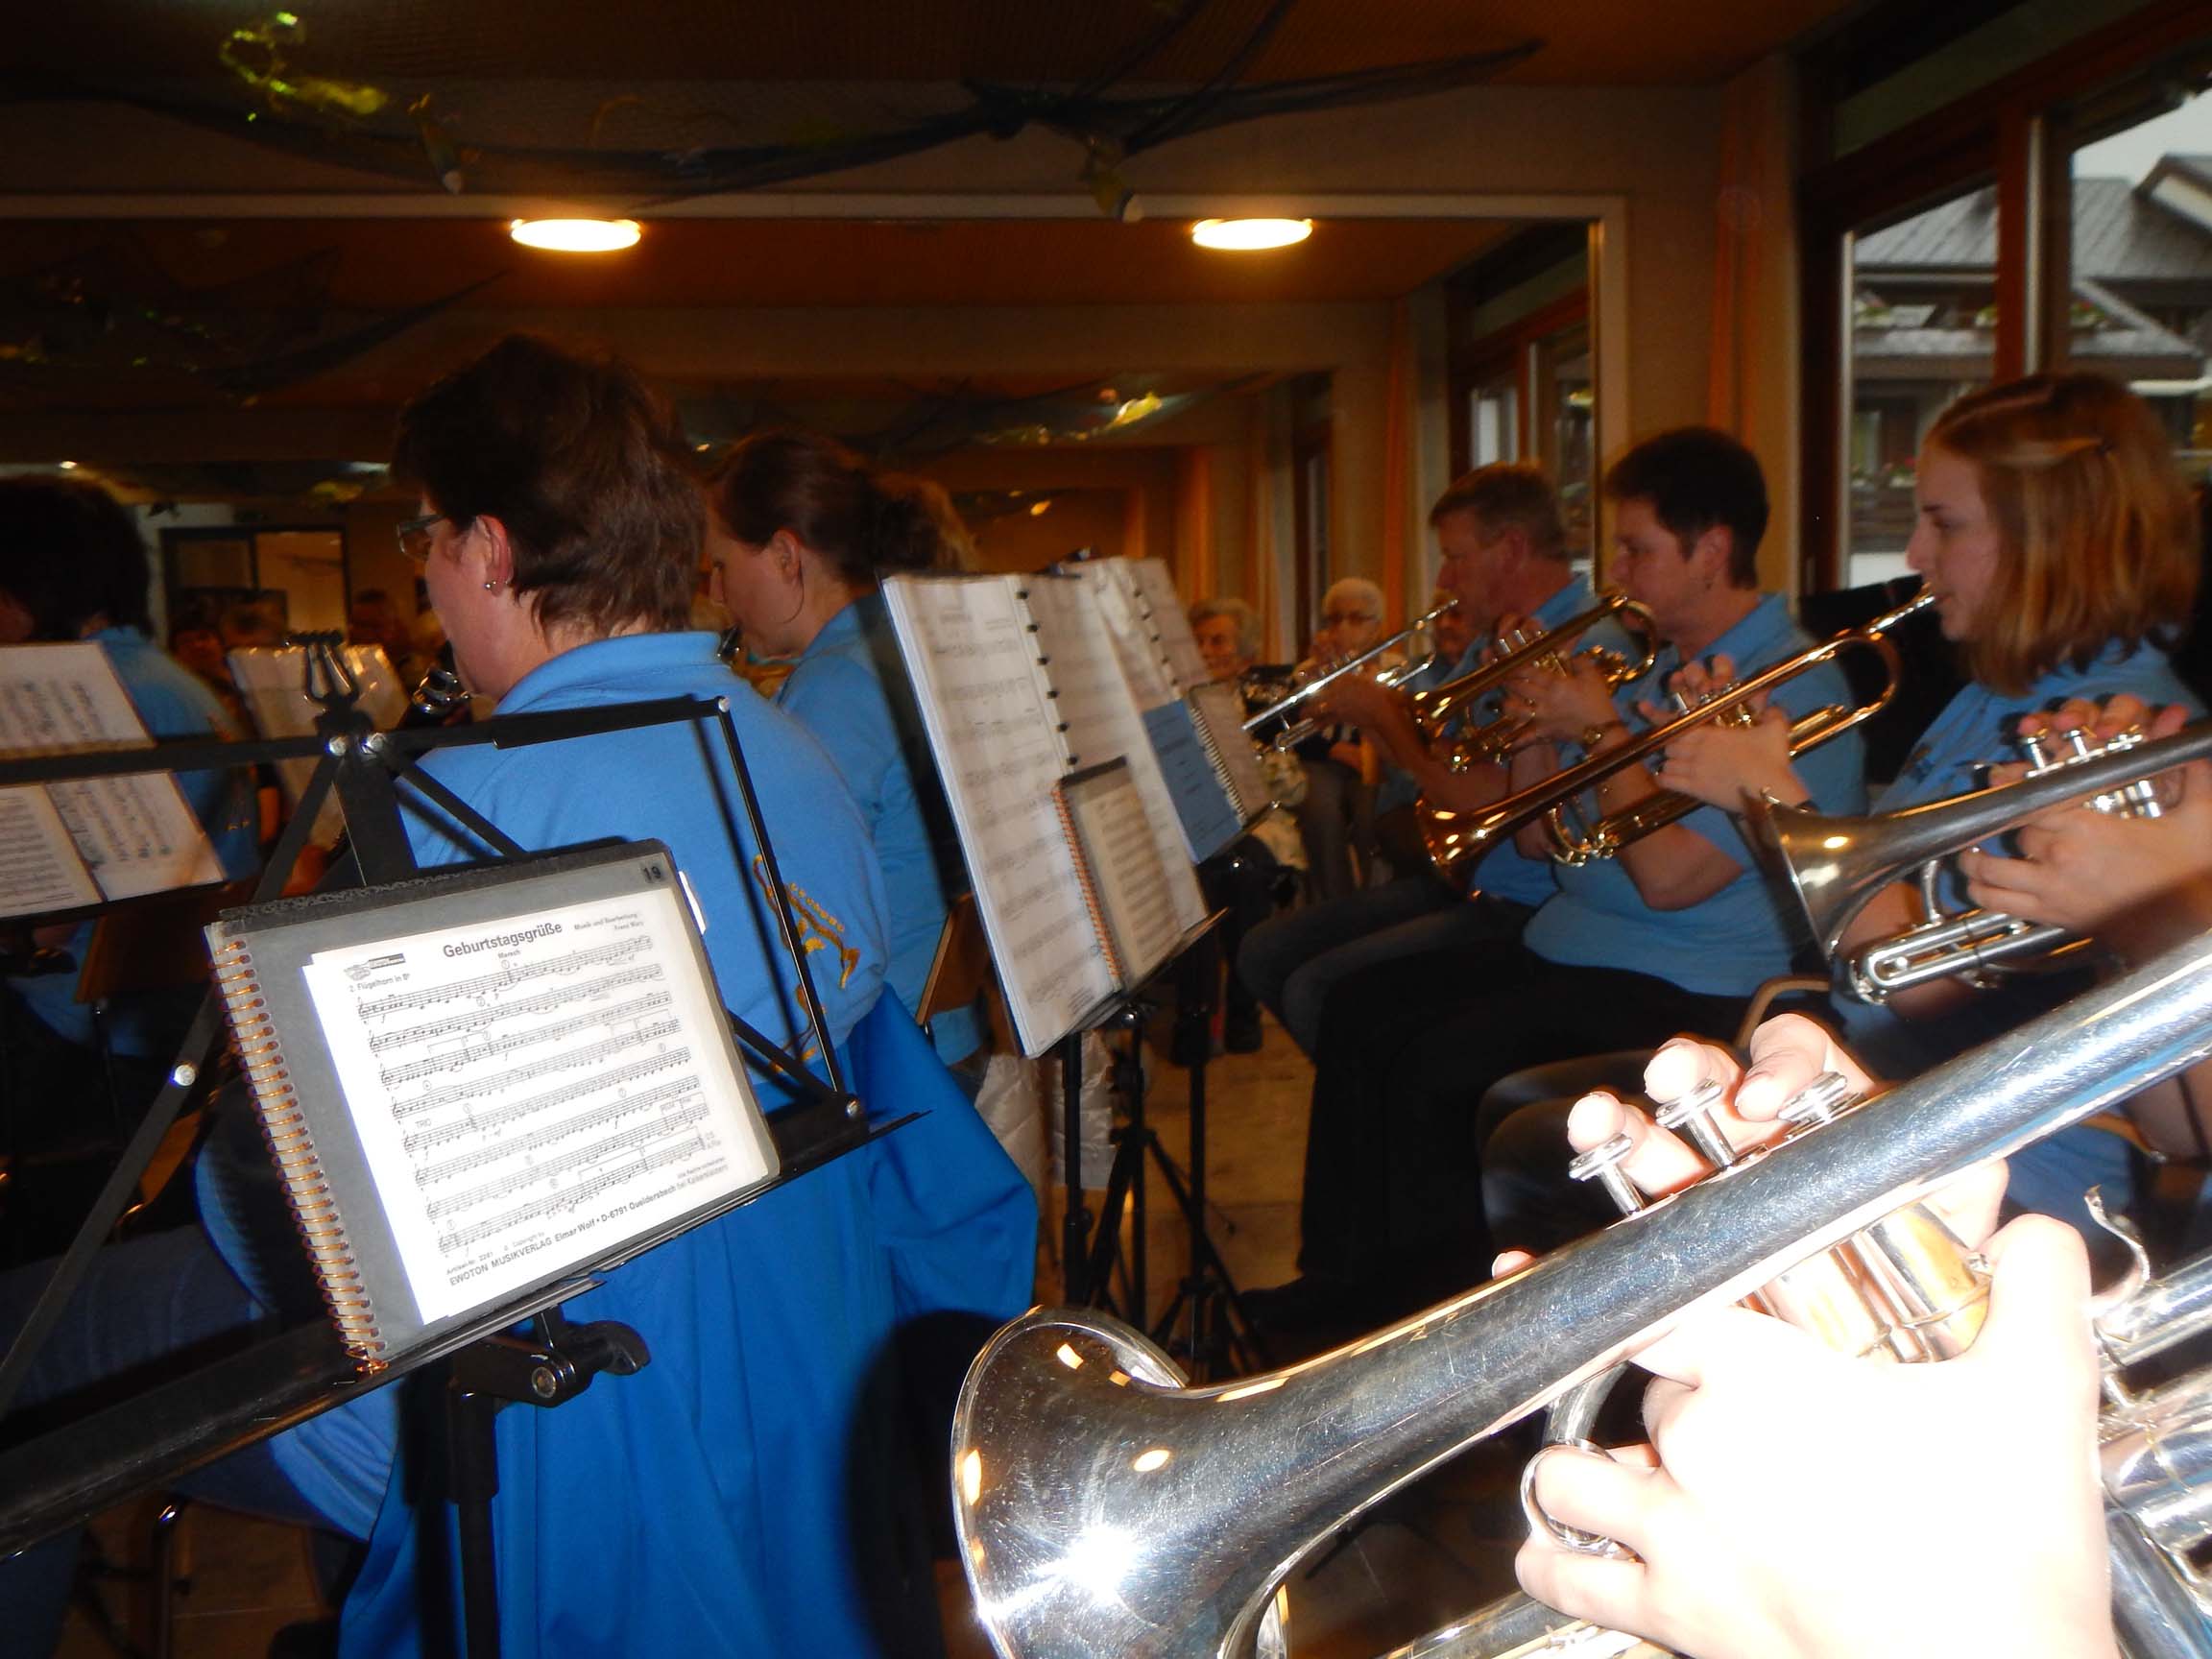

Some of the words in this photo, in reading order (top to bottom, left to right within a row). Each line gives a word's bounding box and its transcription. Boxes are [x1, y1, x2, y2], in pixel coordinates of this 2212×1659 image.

[643, 866, 661, 880] 19
[443, 922, 563, 958] Geburtstagsgrüße
[357, 976, 394, 990] Flügelhorn
[449, 1263, 489, 1286] EWOTON
[491, 1238, 552, 1268] MUSIKVERLAG
[554, 1226, 578, 1242] Elmar
[577, 1218, 595, 1235] Wolf
[601, 1206, 628, 1223] D-6791
